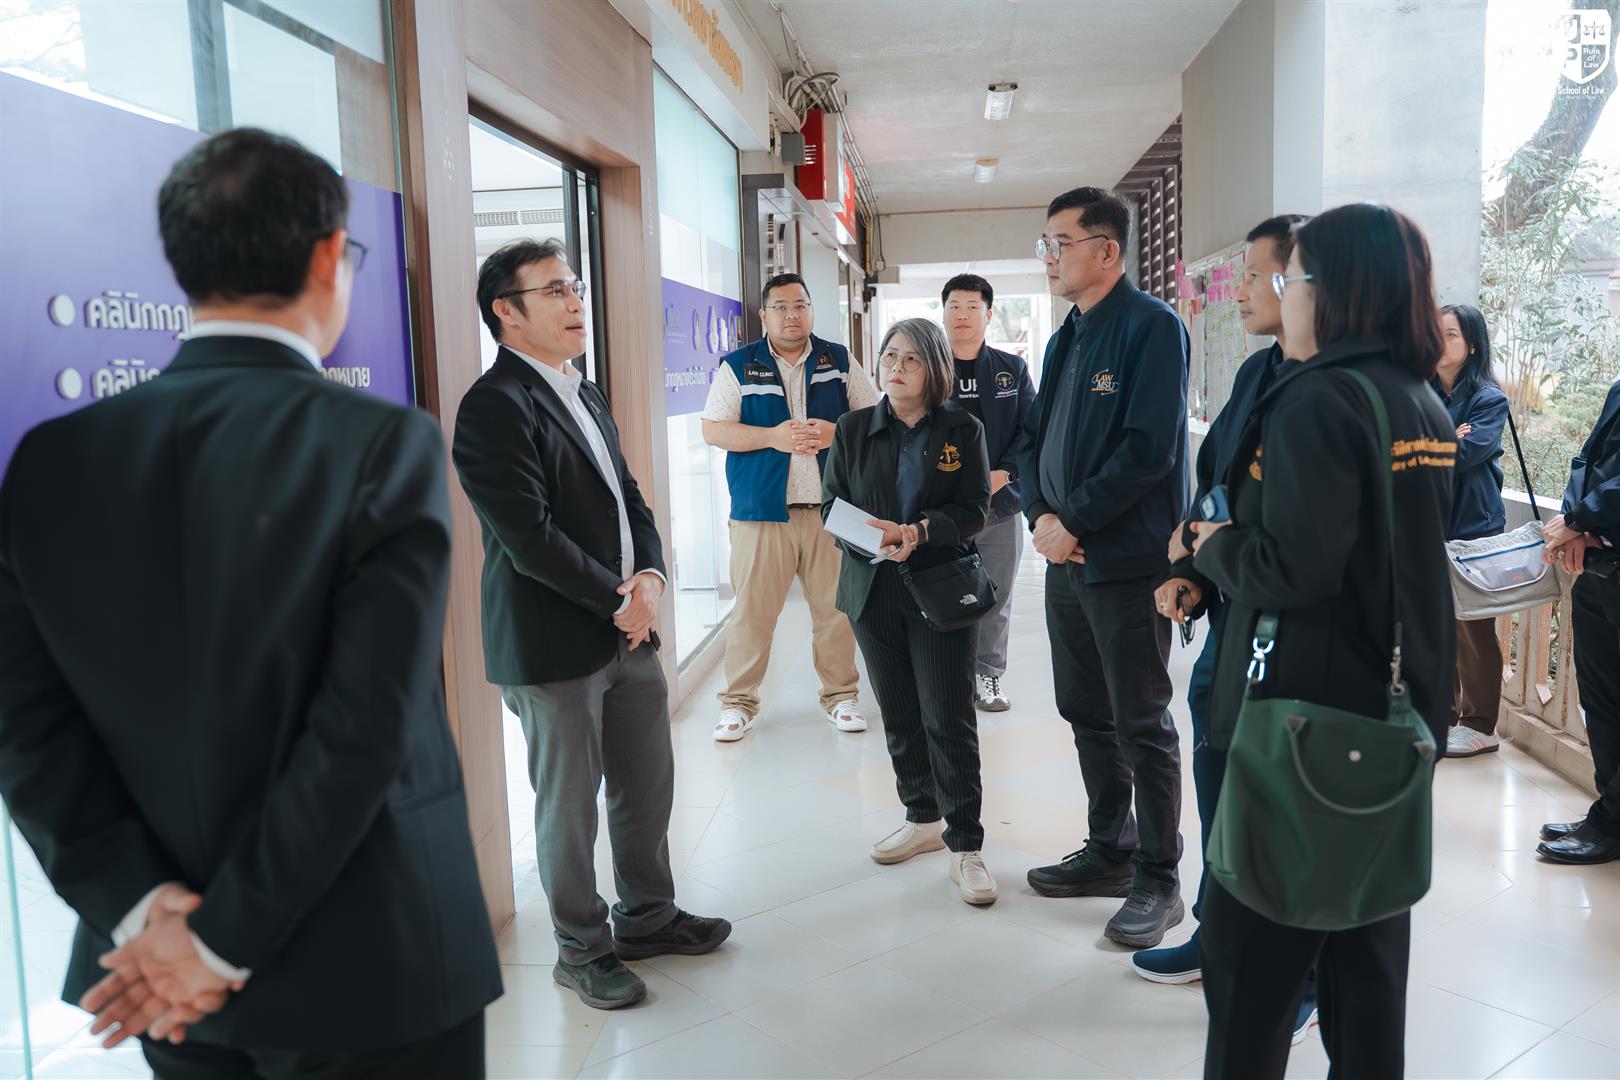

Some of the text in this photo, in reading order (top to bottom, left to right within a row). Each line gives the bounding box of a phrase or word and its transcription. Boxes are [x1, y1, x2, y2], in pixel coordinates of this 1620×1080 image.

[86, 290, 192, 341] คลินิกกฎ
[1094, 374, 1114, 382] LAW
[1096, 381, 1116, 389] MSU
